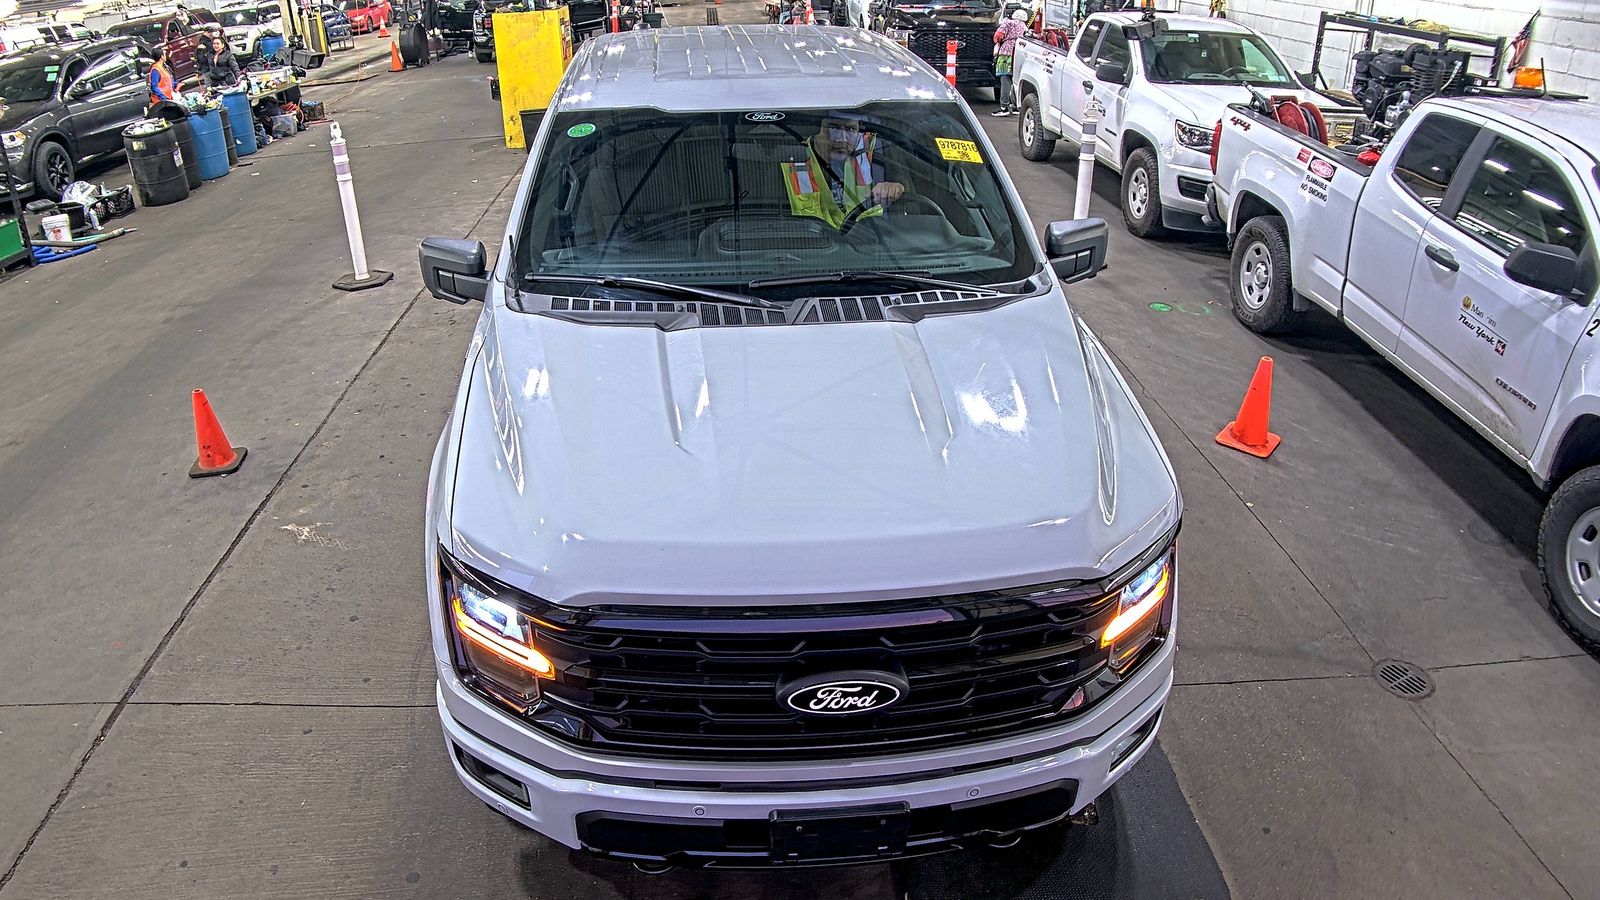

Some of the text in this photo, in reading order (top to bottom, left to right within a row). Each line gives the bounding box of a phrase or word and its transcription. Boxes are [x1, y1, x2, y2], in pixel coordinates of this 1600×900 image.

[752, 112, 778, 120] Ford
[1230, 116, 1252, 131] 4x4
[938, 140, 978, 152] 9787816
[1312, 158, 1334, 177] DANGER
[1305, 174, 1328, 191] FLAMMABLE
[1300, 182, 1328, 202] NO SMOKING
[1458, 314, 1496, 346] New York
[809, 686, 879, 710] Ford
